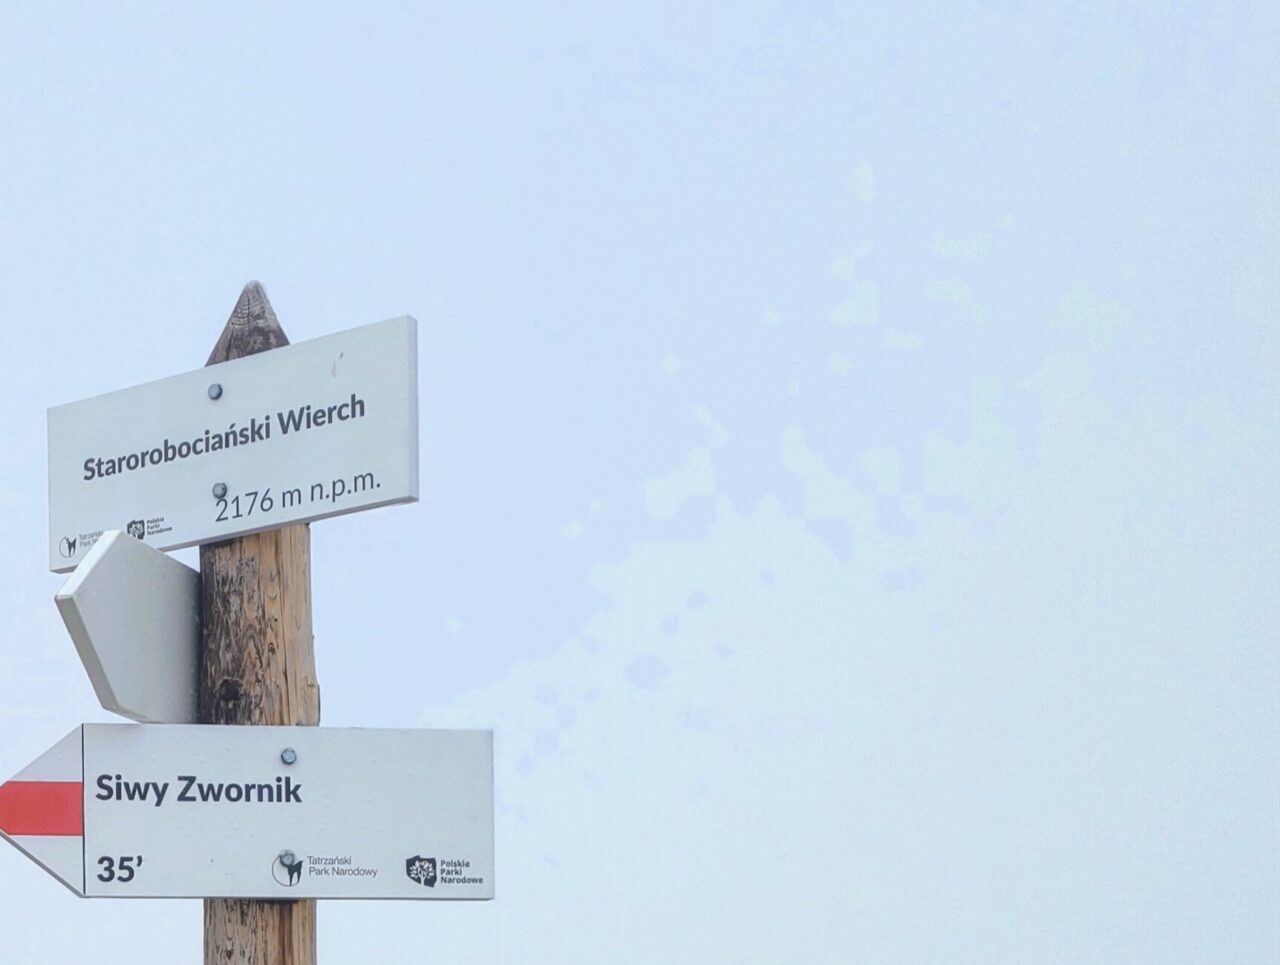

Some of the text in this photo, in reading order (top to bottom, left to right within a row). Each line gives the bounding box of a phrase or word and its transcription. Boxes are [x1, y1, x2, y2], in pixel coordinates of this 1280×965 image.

[83, 394, 366, 481] Starorobociański Wierch
[214, 472, 381, 522] 2176 m n.p.m.
[95, 774, 303, 807] Siwy Zwornik
[307, 855, 352, 866] Tatrzański
[440, 859, 471, 868] Polskie
[308, 866, 378, 878] Park Narodowy
[440, 868, 463, 876] Parki
[440, 876, 484, 884] Narodowe
